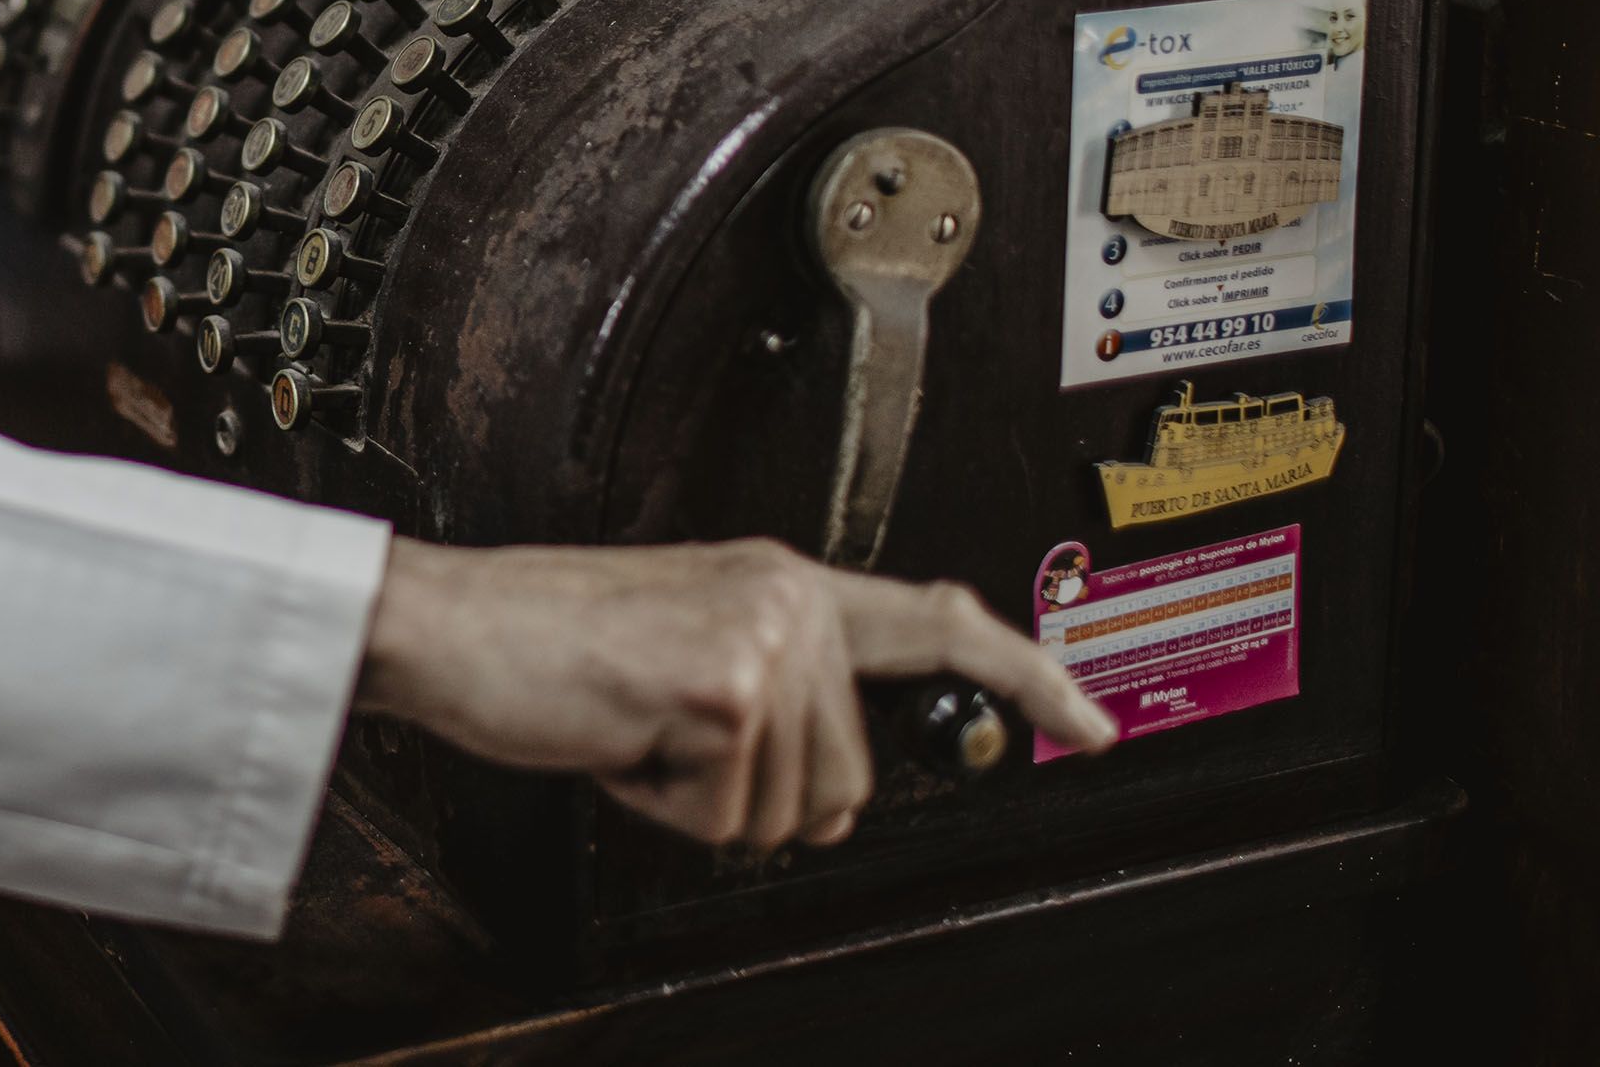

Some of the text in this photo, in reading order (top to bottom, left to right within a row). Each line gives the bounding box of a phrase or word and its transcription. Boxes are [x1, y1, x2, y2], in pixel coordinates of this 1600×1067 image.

[1268, 63, 1281, 73] DE
[362, 109, 380, 138] 5
[1109, 242, 1262, 262] 3 Click sobre PEDIR
[1163, 267, 1274, 290] Confirmamos el pedido
[1104, 286, 1269, 312] 4 Click sobre IMPRIMIR
[1149, 325, 1187, 348] 954
[1191, 321, 1218, 340] 44
[1220, 316, 1245, 335] 99
[1248, 312, 1276, 333] 10
[204, 328, 217, 362] 10
[1162, 339, 1261, 363] www.cecofar.es
[1131, 496, 1187, 518] PUERTO
[1191, 492, 1212, 508] DE
[1213, 481, 1261, 504] SANTA
[1184, 554, 1196, 565] de
[1245, 540, 1257, 550] de
[1259, 533, 1285, 548] Mylan
[1153, 686, 1187, 703] Mylan
